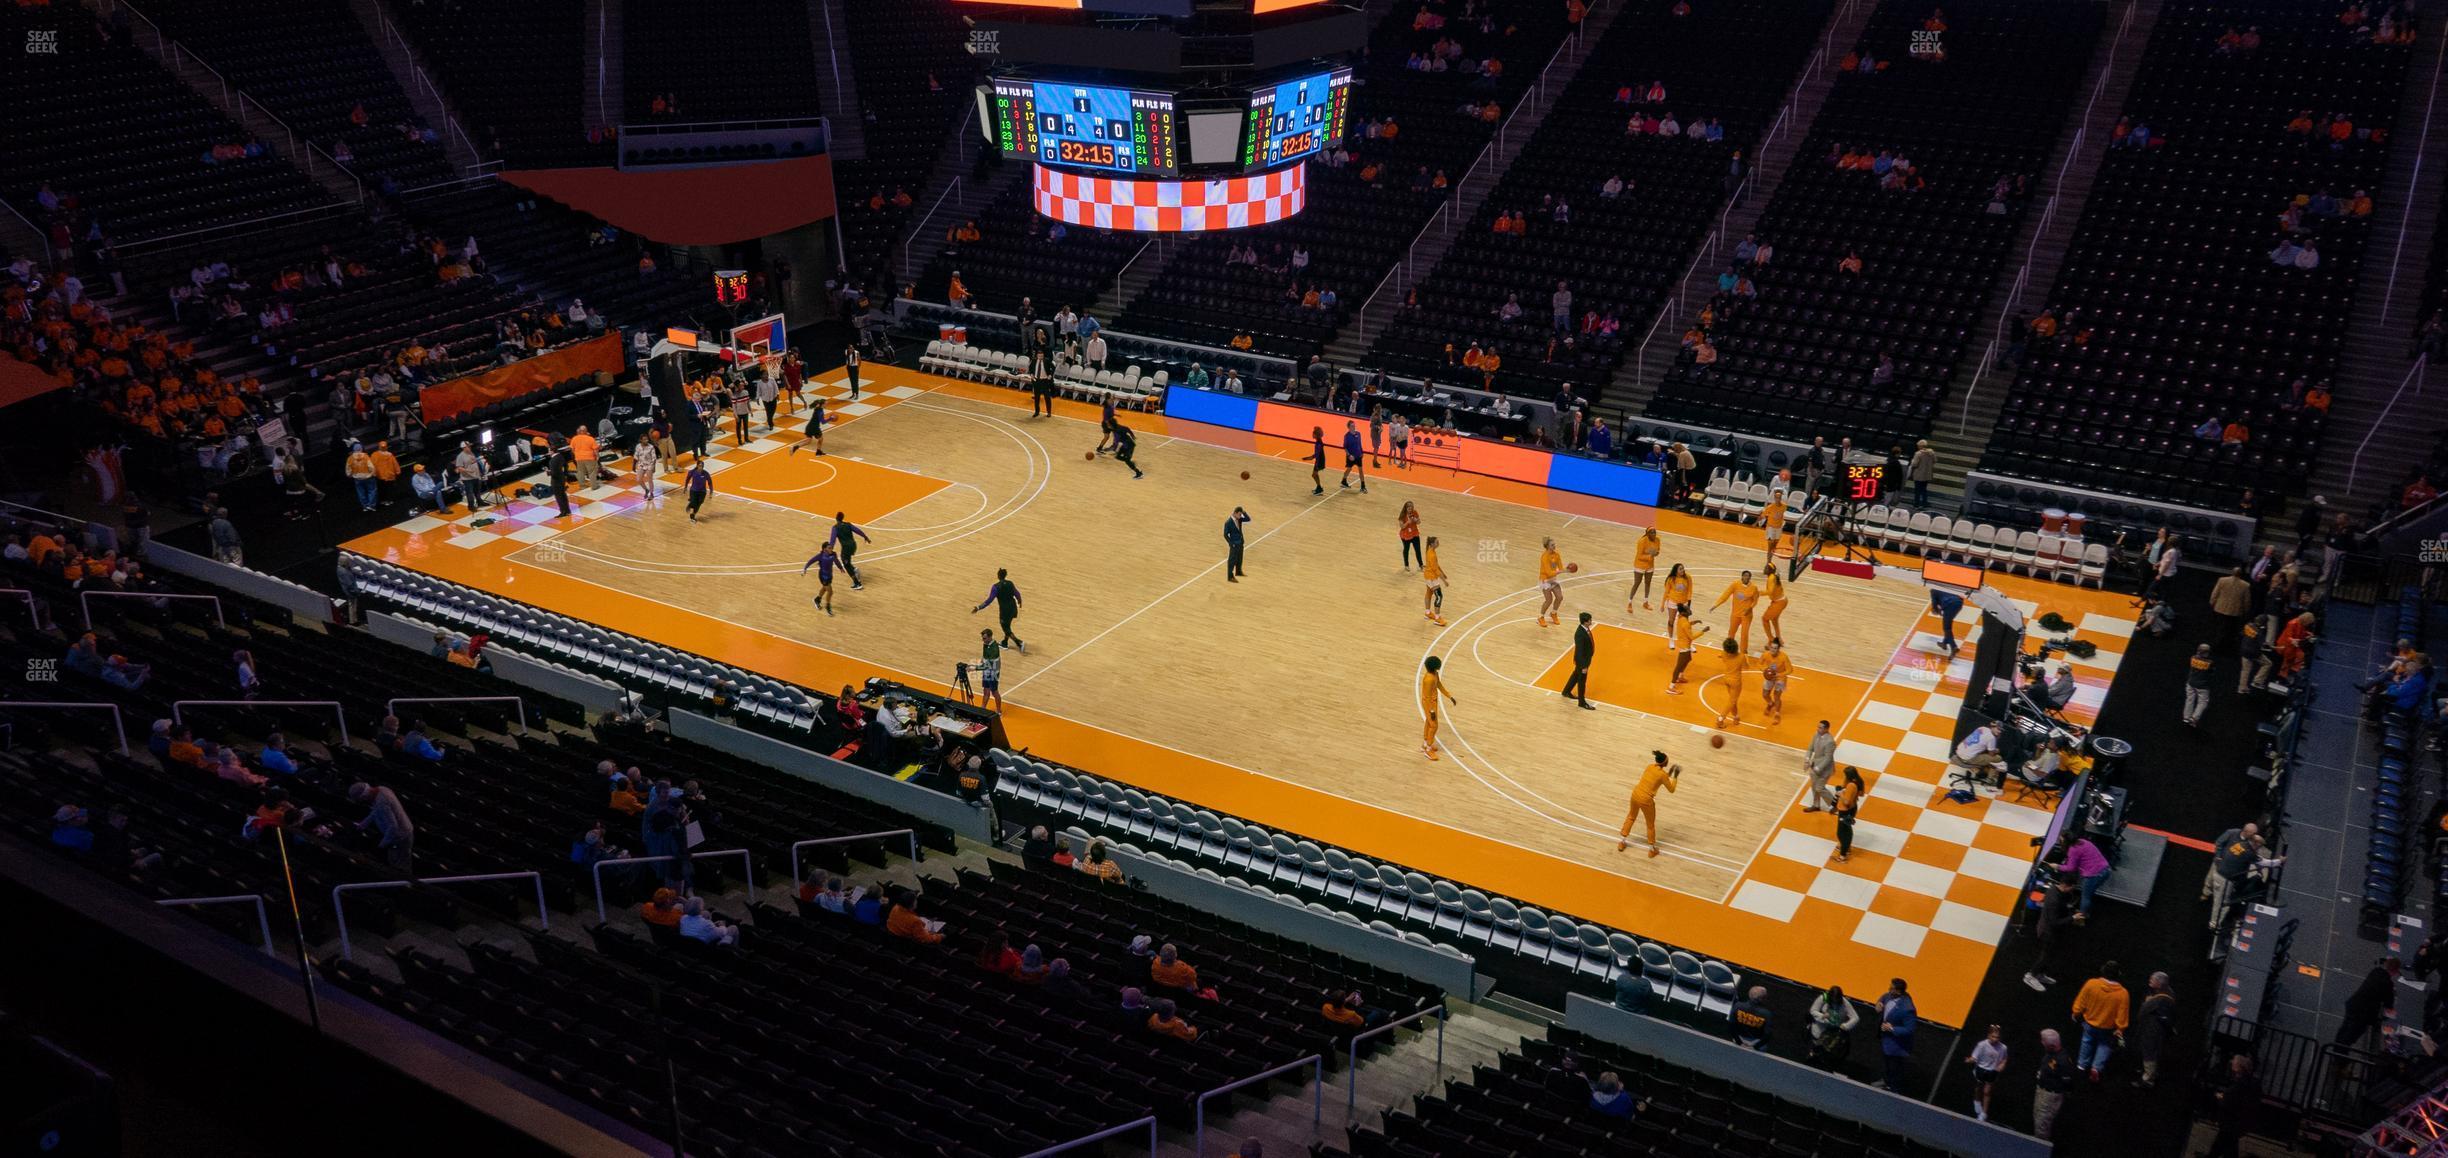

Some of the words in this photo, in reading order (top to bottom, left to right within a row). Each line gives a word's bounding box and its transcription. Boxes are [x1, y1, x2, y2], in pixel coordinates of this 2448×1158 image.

[998, 98, 1009, 108] 00
[1026, 101, 1032, 110] 9
[1160, 101, 1172, 110] PTS
[1026, 112, 1035, 120] 17
[1162, 114, 1170, 123] 0
[1002, 120, 1012, 130] 13
[1028, 122, 1034, 132] 8
[1046, 116, 1055, 131] 0
[1068, 125, 1074, 134] 4
[1135, 123, 1144, 132] 11
[1164, 126, 1170, 134] 7
[1095, 128, 1102, 138] 4
[1114, 123, 1123, 138] 0
[1002, 132, 1012, 140] 23
[1027, 134, 1038, 142] 10
[1135, 134, 1146, 144] 20
[1164, 136, 1170, 146] 7
[1004, 142, 1014, 150] 33
[1030, 144, 1036, 154] 0
[1118, 146, 1130, 155] FLS
[1136, 145, 1146, 154] 21
[1166, 148, 1172, 157] 2
[1281, 132, 1312, 158] 32:15
[1046, 149, 1054, 158] 0
[1060, 142, 1114, 164] 32:15
[1120, 157, 1128, 167] 0
[1136, 156, 1148, 166] 24
[1166, 158, 1172, 168] 0
[733, 284, 746, 301] 30
[1848, 466, 1884, 478] 32:15
[1851, 478, 1877, 498] 30
